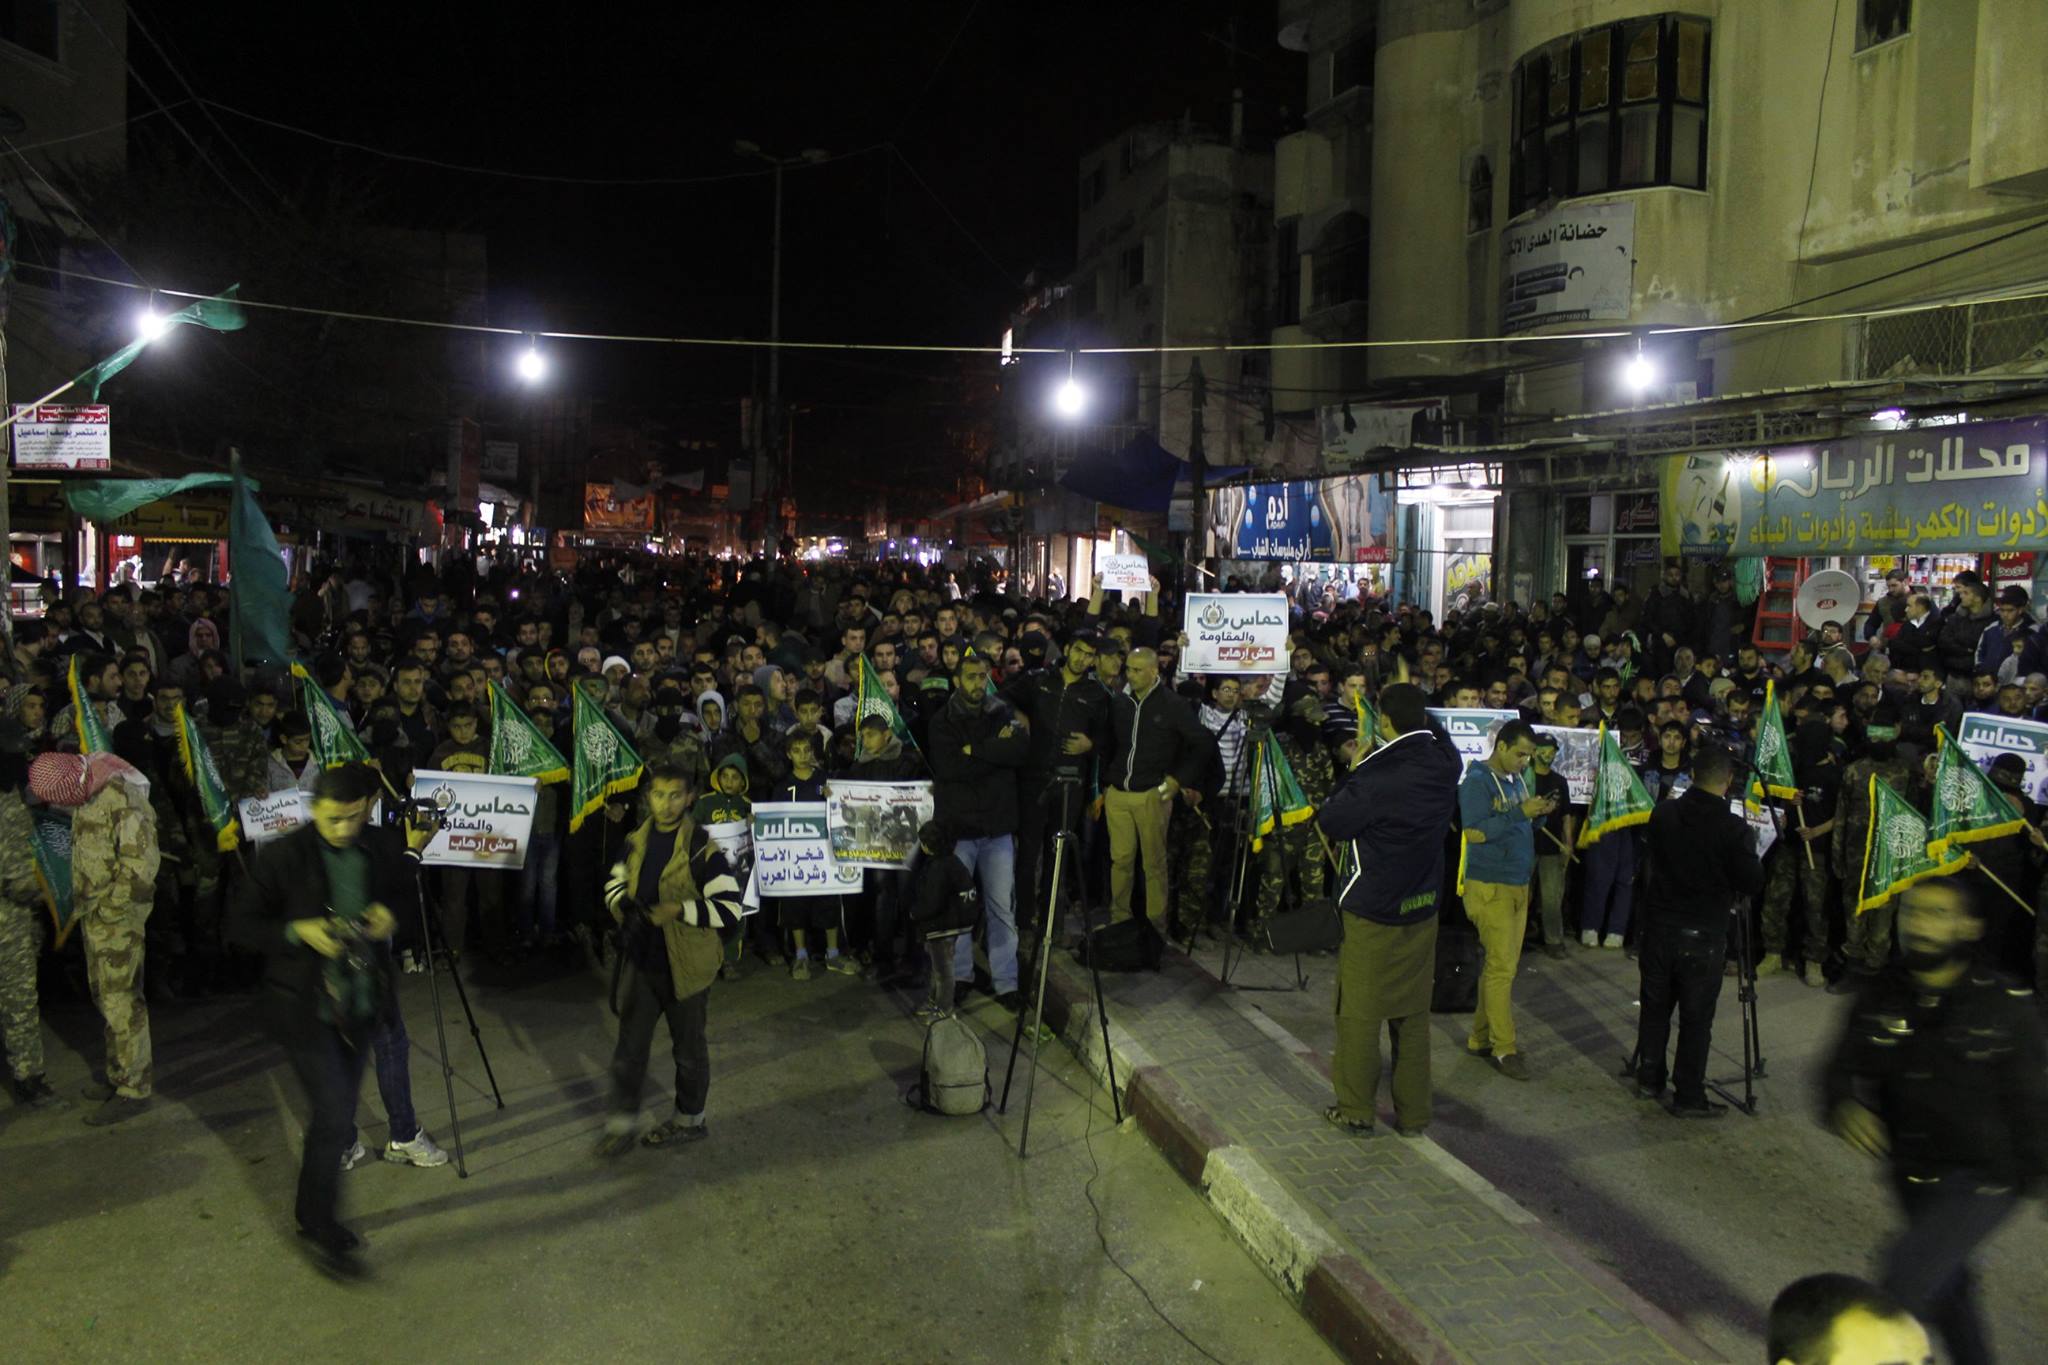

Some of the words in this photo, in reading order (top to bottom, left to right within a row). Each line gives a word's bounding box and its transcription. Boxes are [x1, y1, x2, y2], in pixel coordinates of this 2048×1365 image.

[1560, 223, 1607, 242] حضانة
[1905, 436, 2030, 483] محلات
[1775, 443, 1896, 499] الريان
[1265, 481, 1289, 530] آدم
[1749, 499, 1793, 551] البناء
[1797, 501, 1858, 550] وأدوات
[1858, 502, 1971, 549] الكهربائية
[1230, 609, 1283, 631] حماس
[1199, 630, 1255, 646] والمقاومة
[1219, 646, 1250, 662] إرهاب
[1251, 647, 1273, 661] مش
[1459, 742, 1483, 755] فخ
[1964, 727, 2037, 751] حماس
[265, 798, 298, 814] حماس
[463, 796, 531, 818] حماس
[443, 818, 493, 834] والمقاو
[756, 816, 821, 841] حماس
[450, 835, 487, 852] إرهاب
[488, 837, 515, 852] مش
[793, 846, 825, 865] فخر
[760, 867, 791, 886] العرب
[793, 864, 827, 885] وشرف
